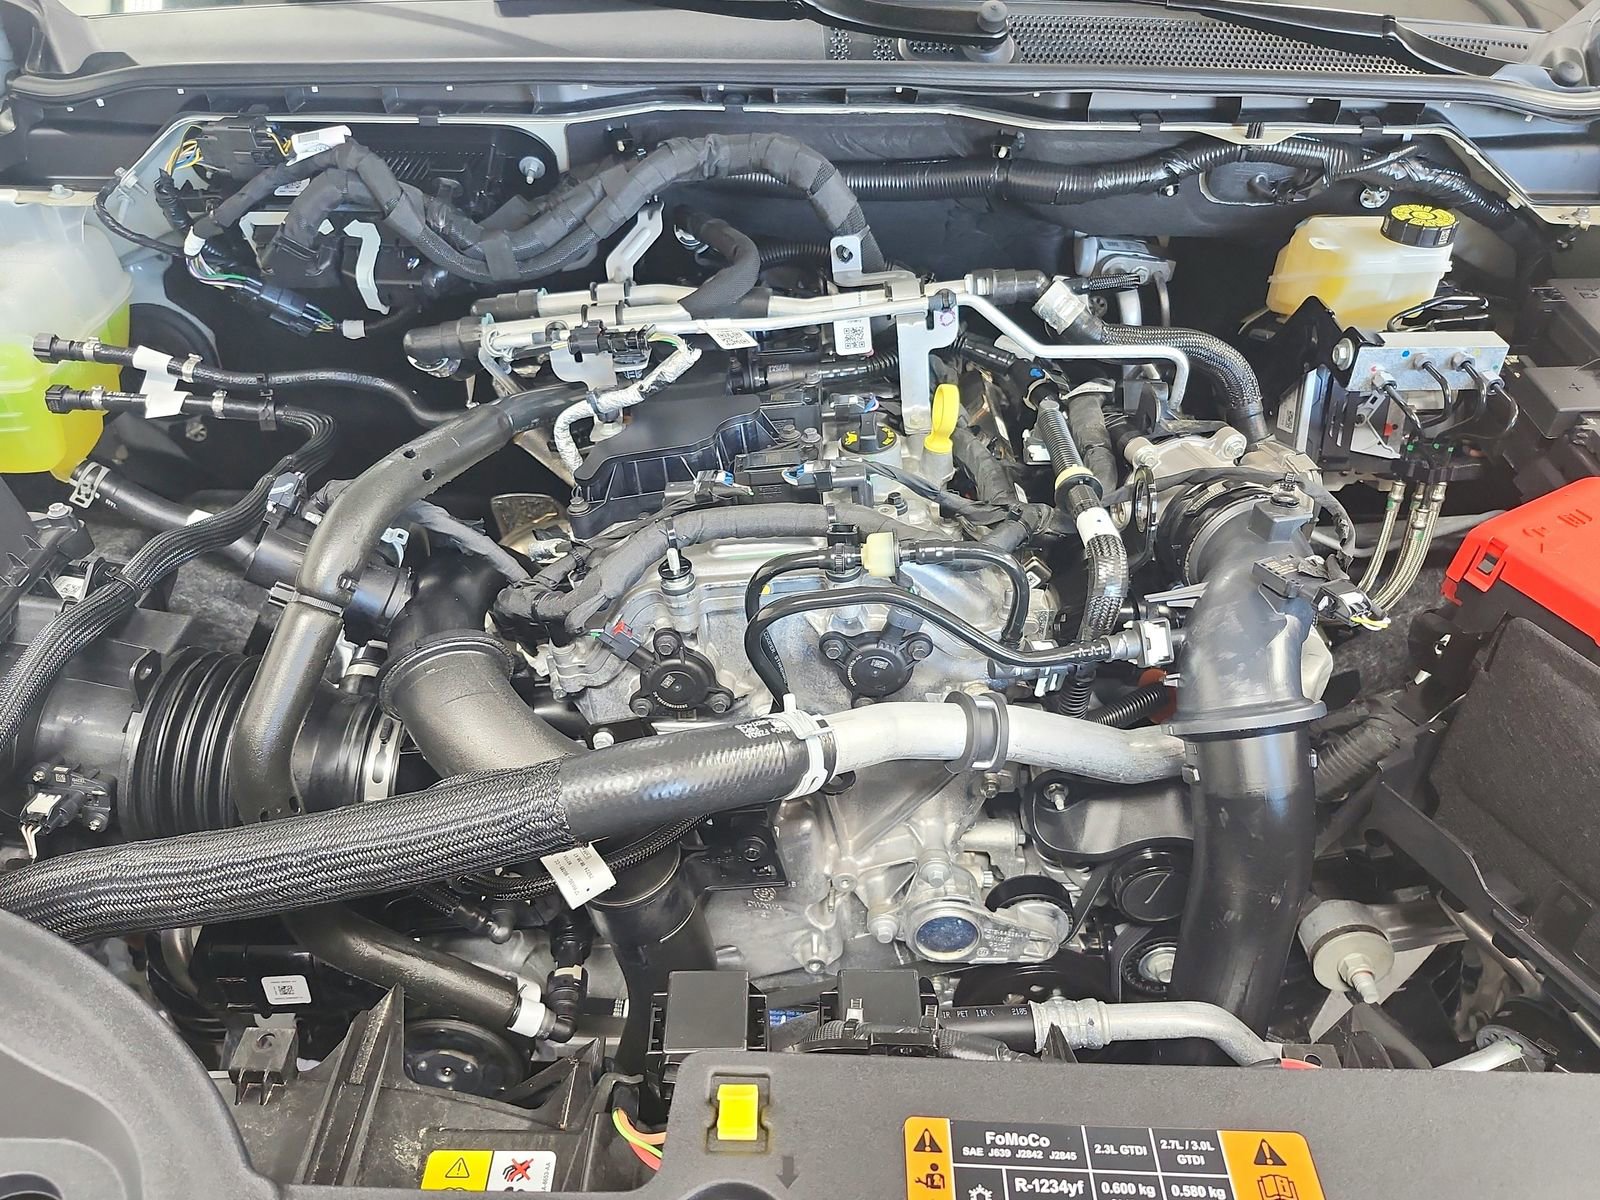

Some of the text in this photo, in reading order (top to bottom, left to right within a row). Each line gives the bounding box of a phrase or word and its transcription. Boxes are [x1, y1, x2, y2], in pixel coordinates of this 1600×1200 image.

[956, 1010, 969, 1018] PET
[985, 1131, 1051, 1147] FoMoCo
[1160, 1139, 1184, 1151] 2.7L
[1190, 1140, 1216, 1152] 3.0L
[962, 1146, 1078, 1161] SAE J639 J2842 J2845
[1094, 1143, 1148, 1156] 2.3L GTDI
[1176, 1154, 1206, 1166] GTDI
[1014, 1177, 1085, 1198] R-1234yf
[1100, 1181, 1157, 1198] 0.600 kg
[1170, 1184, 1227, 1200] 0.580 kg
